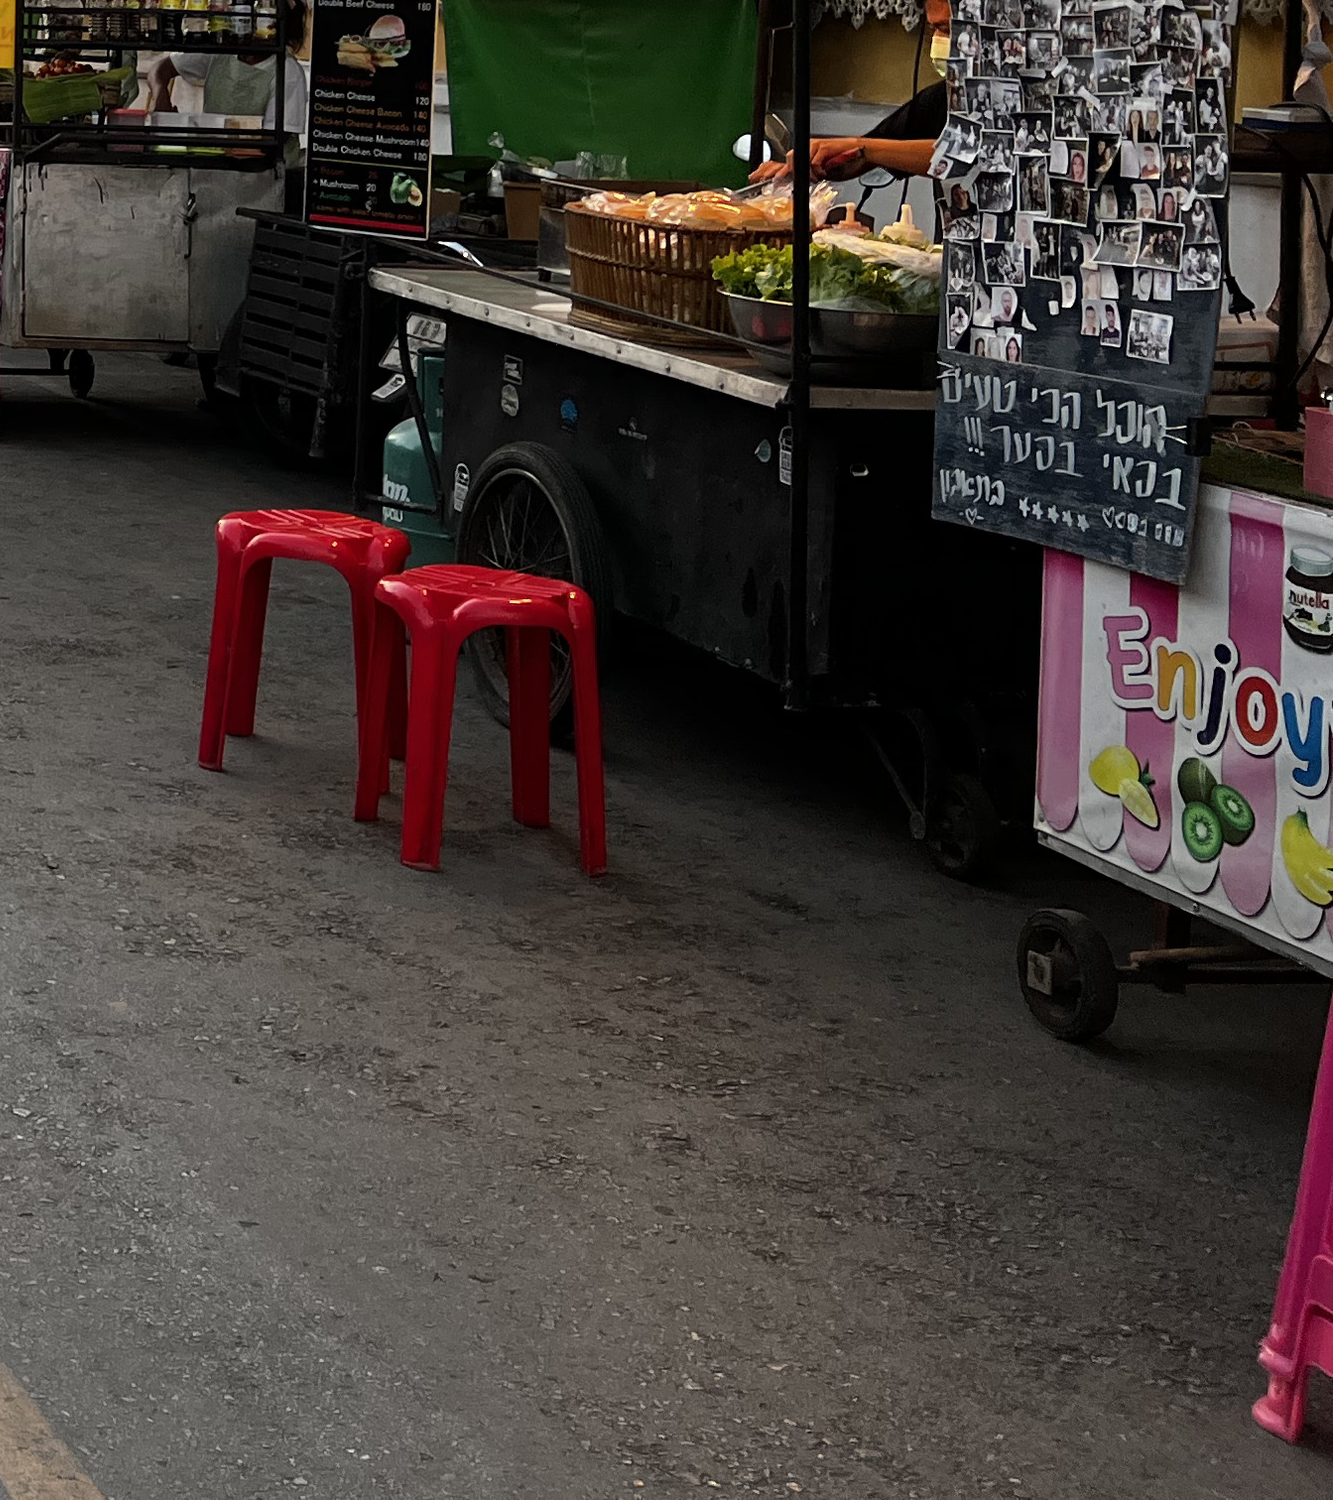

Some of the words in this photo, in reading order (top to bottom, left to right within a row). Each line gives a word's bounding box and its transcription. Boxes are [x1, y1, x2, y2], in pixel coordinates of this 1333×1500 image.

[345, 0, 364, 8] Beef
[366, 0, 395, 9] Cheese
[315, 89, 345, 98] Chicken
[347, 91, 376, 102] Cheese
[415, 97, 430, 106] 120
[314, 103, 344, 112] Chicken
[346, 105, 375, 115] Cheese
[313, 129, 343, 140] Chicken
[345, 132, 374, 142] Cheese
[376, 135, 415, 146] Mushroom
[313, 143, 338, 153] Double
[340, 145, 371, 156] Chicken
[373, 149, 403, 159] Cheese
[320, 179, 360, 190] Mushroom
[366, 183, 377, 192] 20
[1031, 387, 1081, 430] הכי
[1289, 589, 1330, 610] nutella
[1101, 610, 1326, 786] Enjoy
